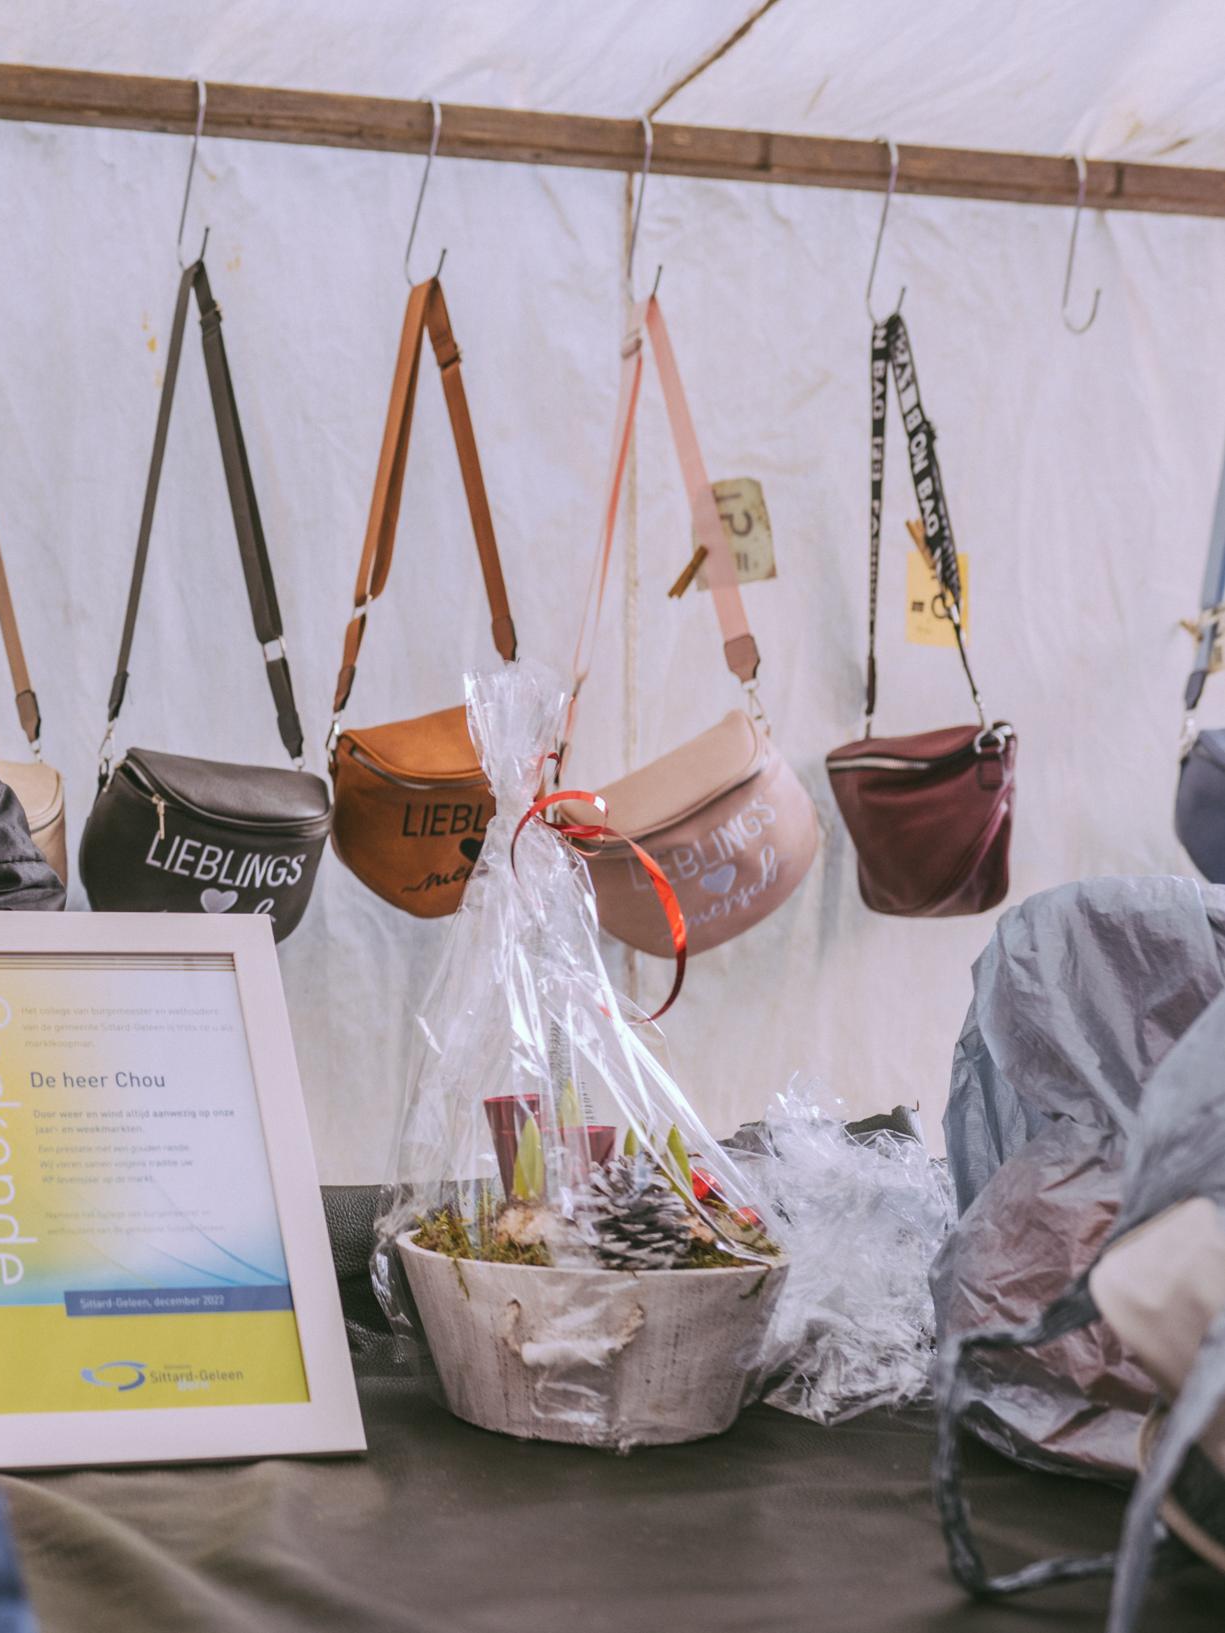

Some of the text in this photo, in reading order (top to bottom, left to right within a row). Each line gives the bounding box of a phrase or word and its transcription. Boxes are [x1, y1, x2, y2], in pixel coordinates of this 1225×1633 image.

[402, 802, 487, 837] LIEBL
[628, 796, 776, 891] LEBLINGS
[145, 830, 307, 888] LIEBLINGS
[30, 1071, 166, 1088] De heer Chou
[33, 1108, 235, 1120] Door weer en wind altijd aanwezig op onze
[62, 1125, 74, 1134] en
[154, 1295, 200, 1307] december
[150, 1369, 244, 1384] Sittard-Geleen
